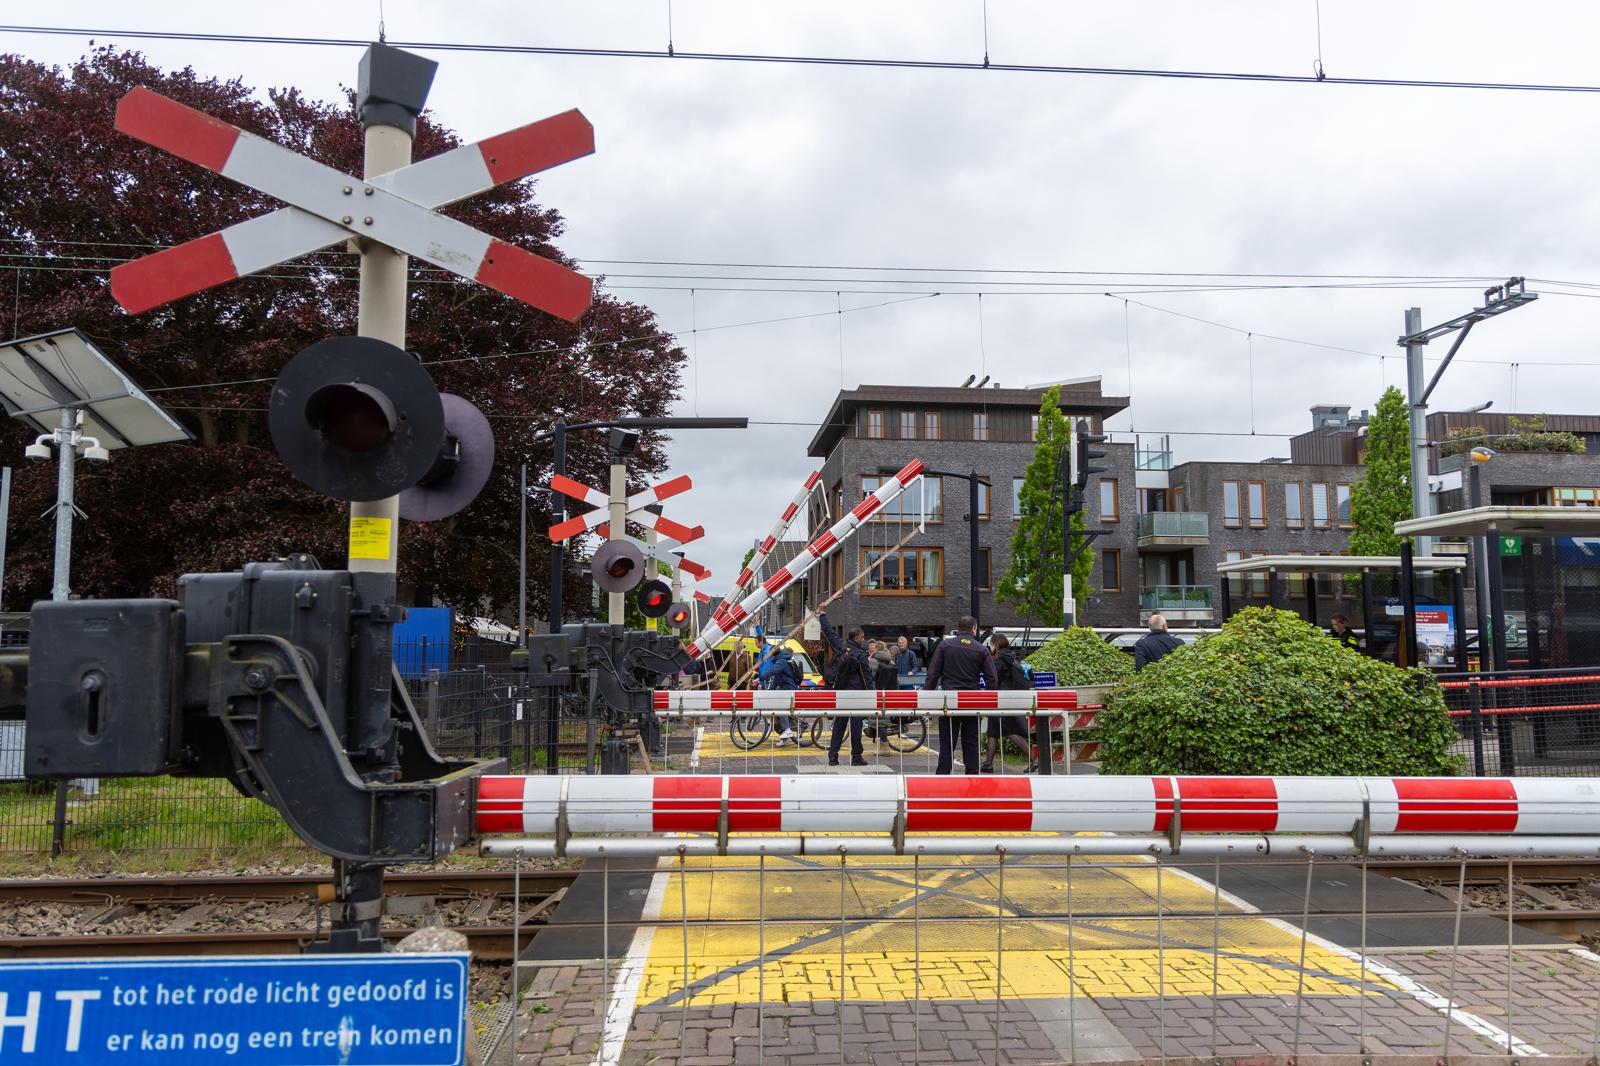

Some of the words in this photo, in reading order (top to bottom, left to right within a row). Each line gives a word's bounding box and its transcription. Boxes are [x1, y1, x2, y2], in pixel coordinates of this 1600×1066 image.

[113, 985, 148, 1006] tot
[156, 983, 196, 1005] het
[203, 987, 258, 1004] rode
[266, 982, 320, 1003] licht
[327, 979, 426, 1008] gedoofd
[435, 978, 454, 1000] is
[107, 1034, 133, 1051] er
[141, 1030, 184, 1050] kan
[193, 1032, 239, 1055] nog
[248, 1031, 292, 1048] een
[370, 1025, 452, 1045] komen
